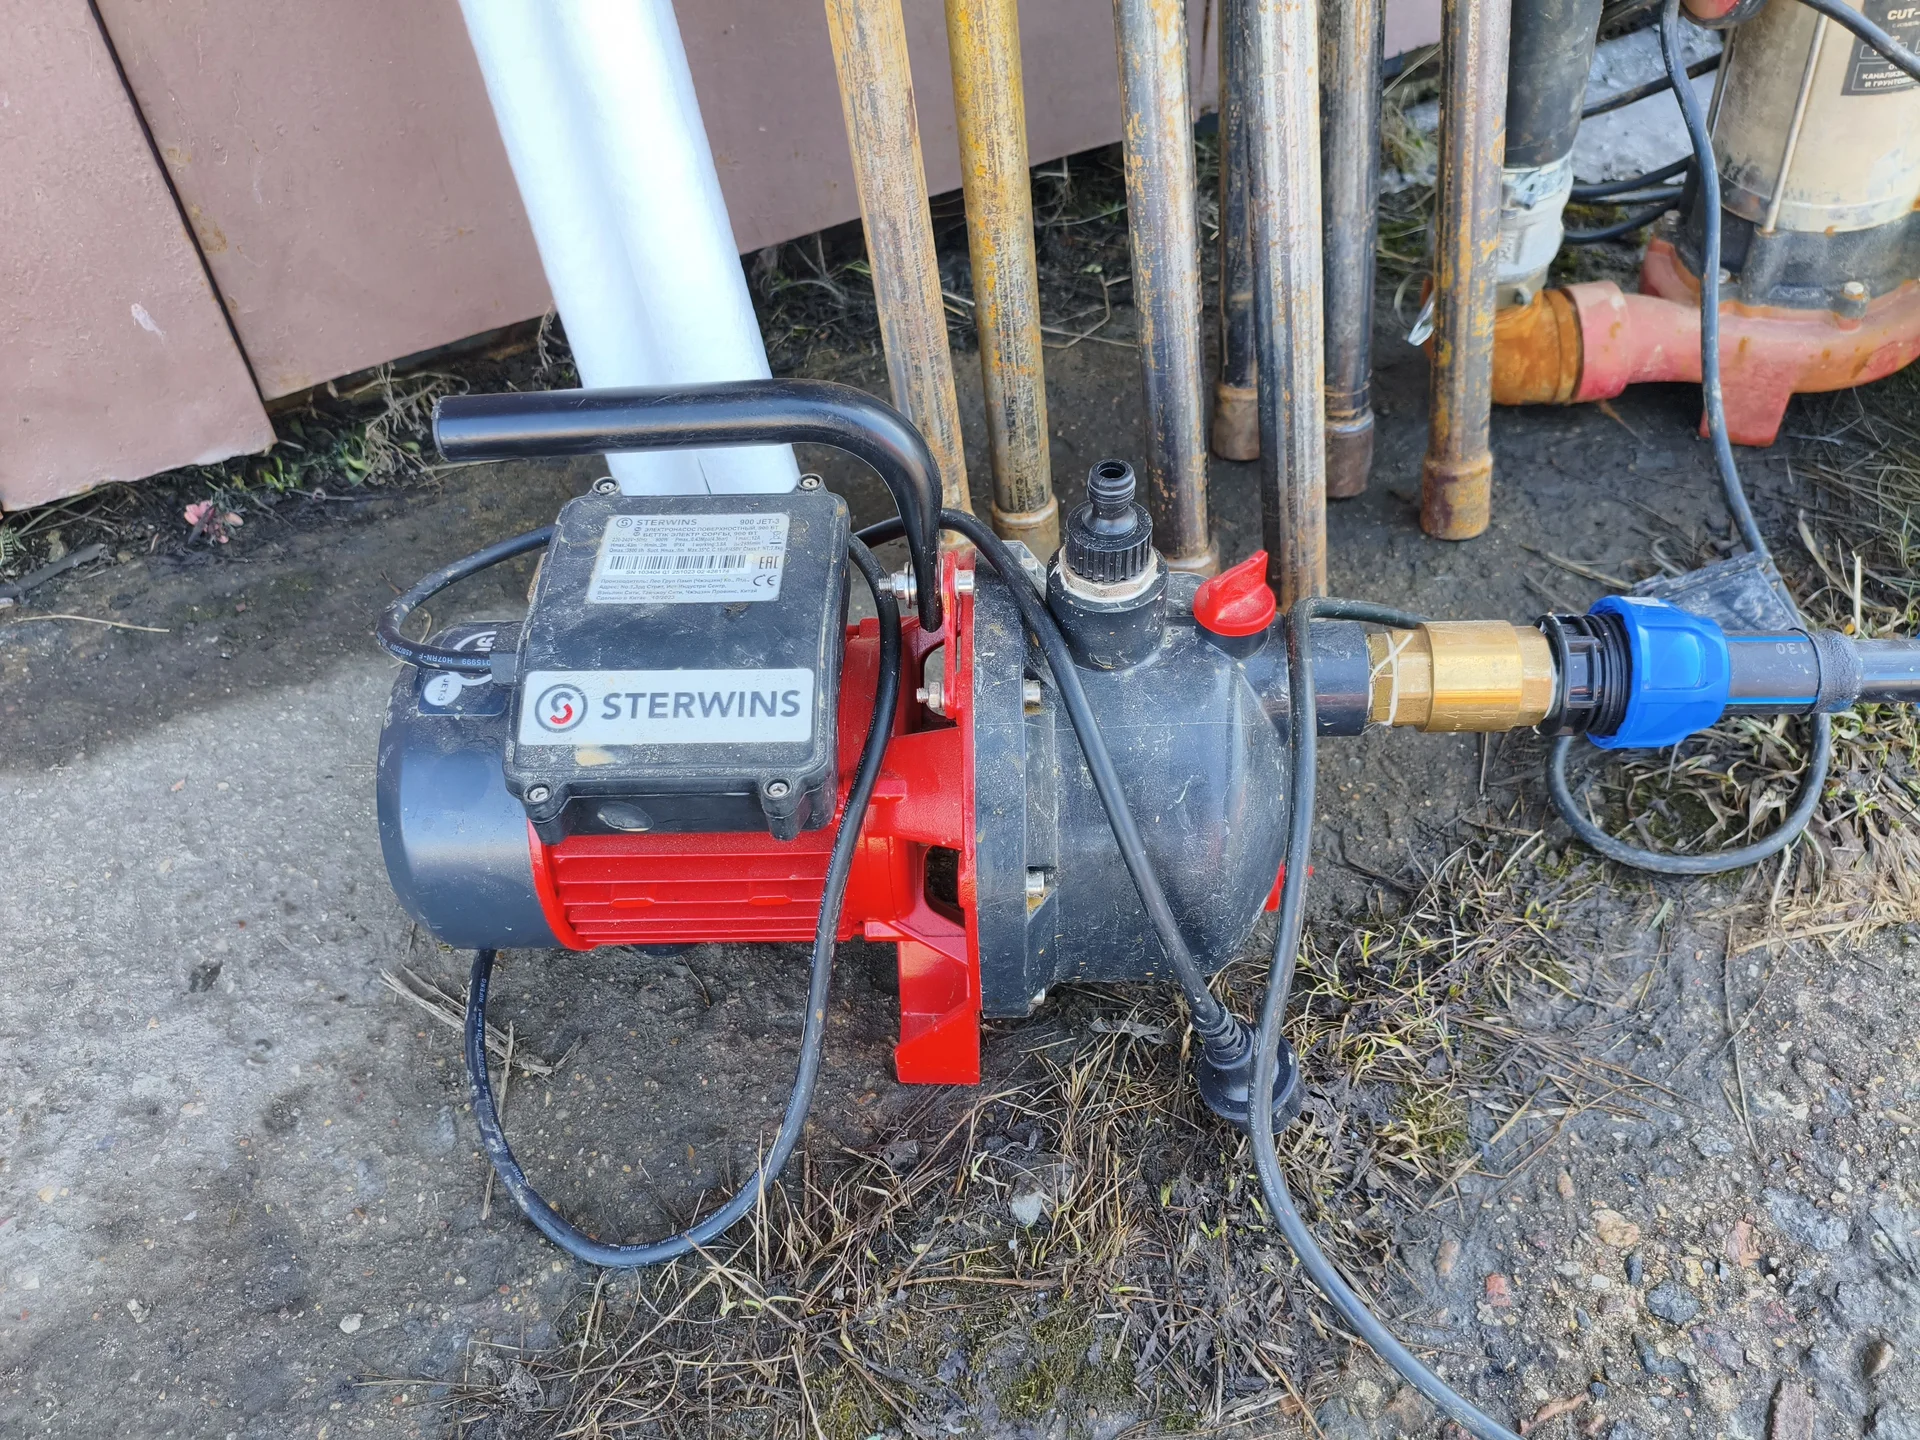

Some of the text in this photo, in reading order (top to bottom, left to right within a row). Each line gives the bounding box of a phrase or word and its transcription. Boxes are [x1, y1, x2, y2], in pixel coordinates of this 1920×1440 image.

[636, 518, 697, 526] STERWINS
[419, 653, 453, 665] H07RN-F
[601, 689, 801, 720] STERWINS
